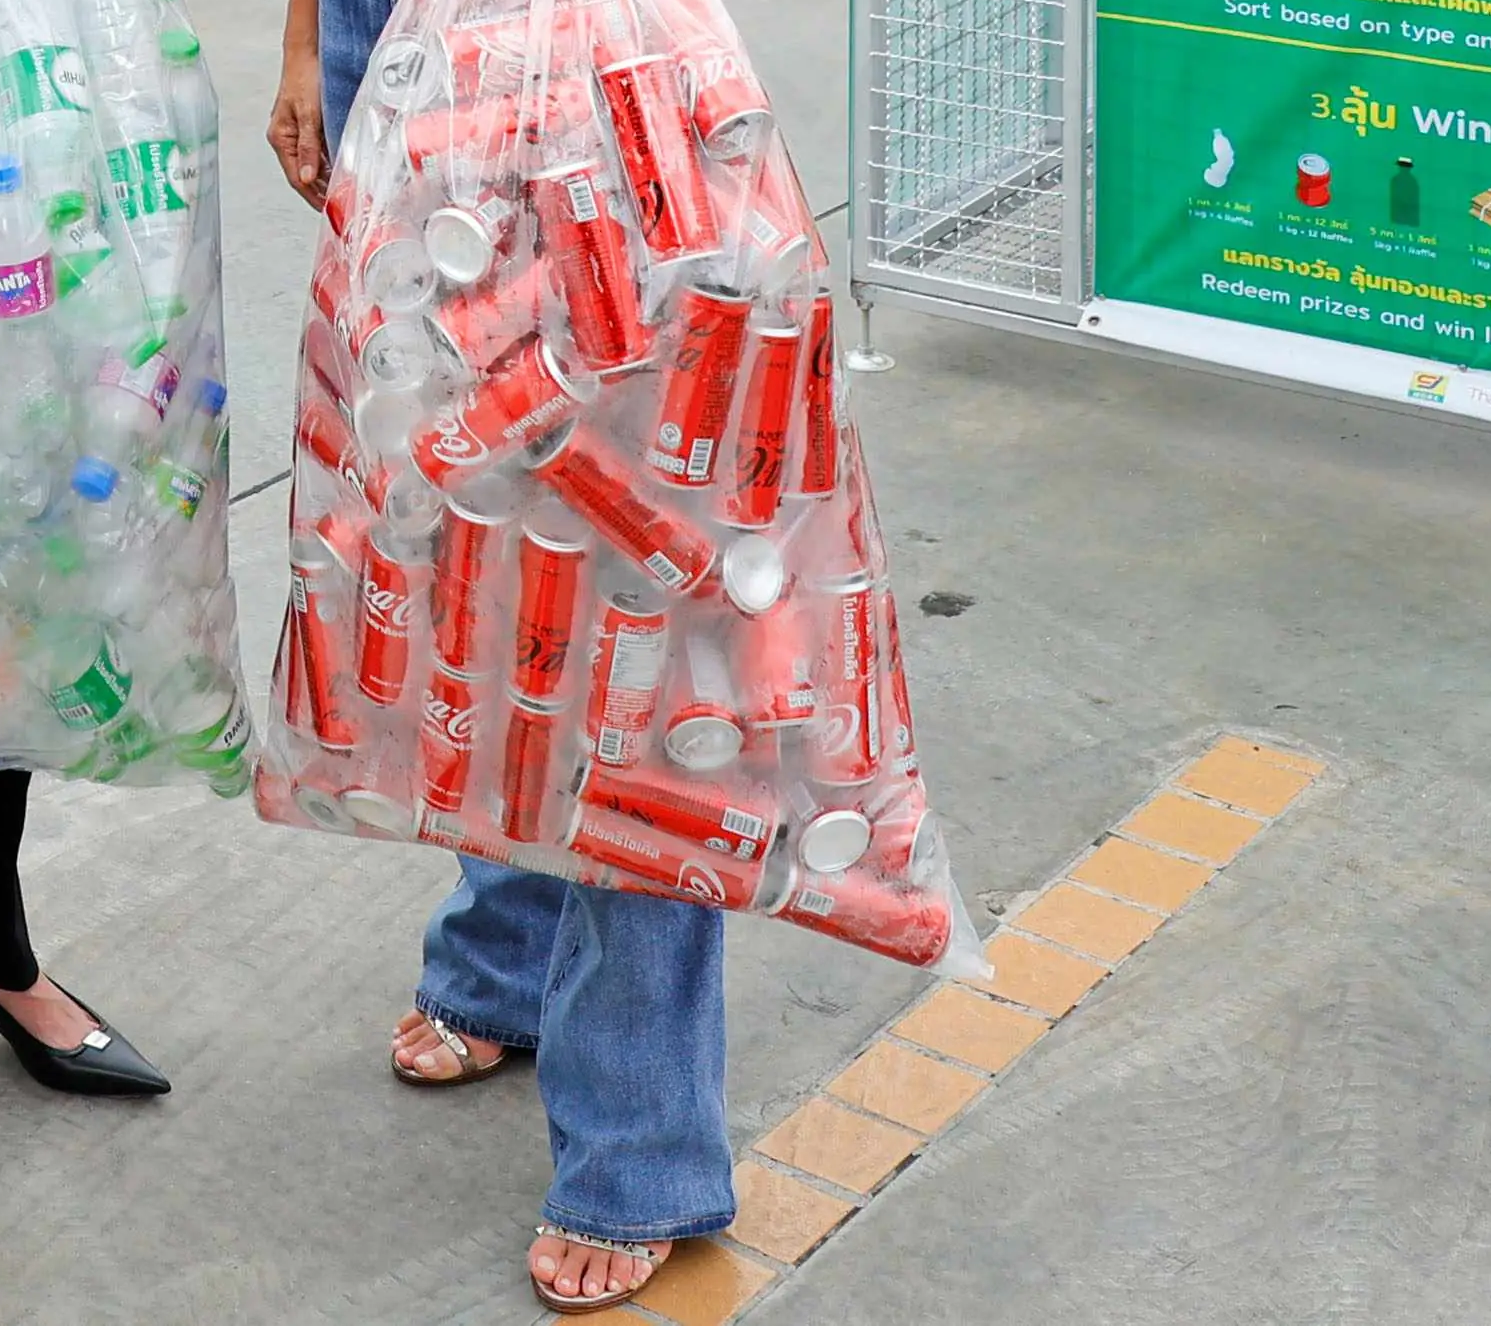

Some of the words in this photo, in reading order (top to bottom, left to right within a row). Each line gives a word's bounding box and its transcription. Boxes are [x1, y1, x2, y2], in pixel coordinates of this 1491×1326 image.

[1280, 3, 1351, 31] based
[1360, 17, 1391, 36] on
[1399, 18, 1455, 46] type
[1224, 247, 1341, 283] แลกรางวัล
[1201, 274, 1291, 306] Redeem
[1300, 293, 1371, 322] prizes
[1380, 307, 1425, 332] and
[1434, 319, 1475, 341] win
